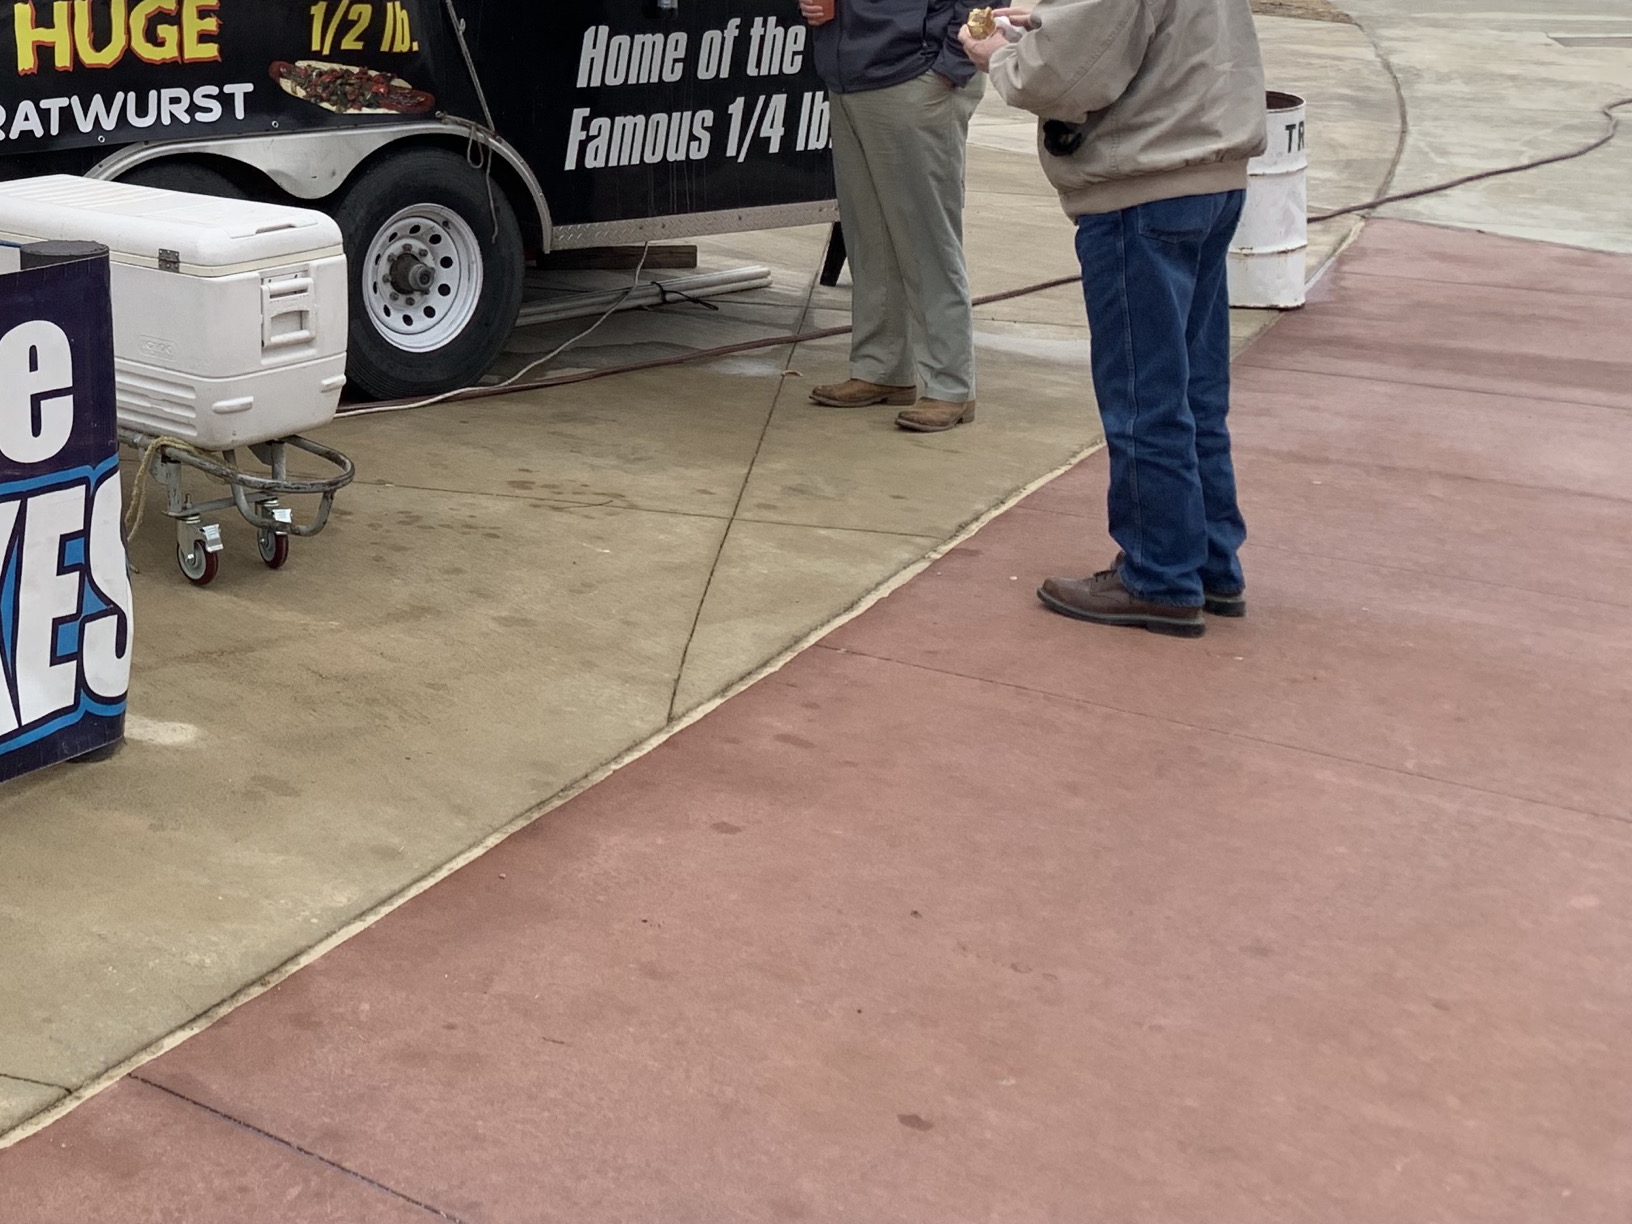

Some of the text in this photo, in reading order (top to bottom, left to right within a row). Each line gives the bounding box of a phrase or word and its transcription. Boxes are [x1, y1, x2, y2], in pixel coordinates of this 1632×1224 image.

[309, 0, 420, 55] 1/2 lb.
[576, 15, 807, 88] Home of the
[564, 106, 714, 172] Famous
[726, 93, 789, 163] 1/4
